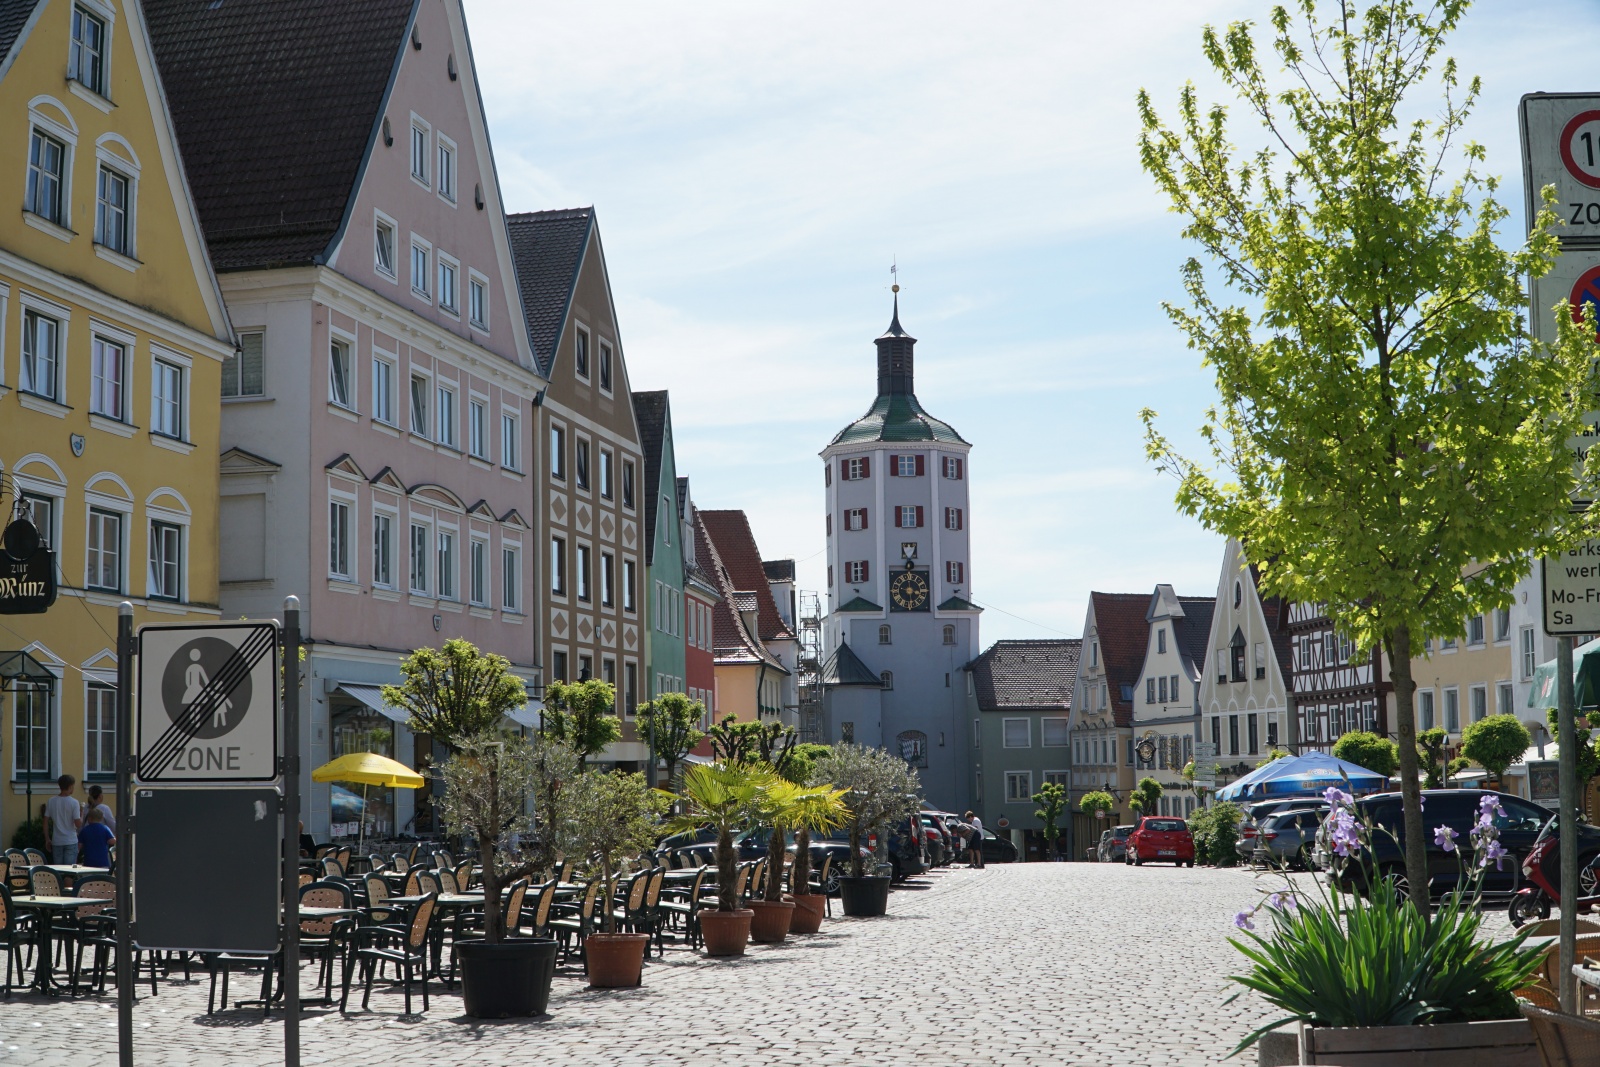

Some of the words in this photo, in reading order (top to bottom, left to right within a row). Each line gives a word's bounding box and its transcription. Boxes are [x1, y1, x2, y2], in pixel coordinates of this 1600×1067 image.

[1580, 131, 1600, 167] 1
[10, 563, 29, 573] zur
[1565, 562, 1600, 578] wer
[1553, 610, 1573, 625] Sa
[172, 746, 241, 771] ZONE
